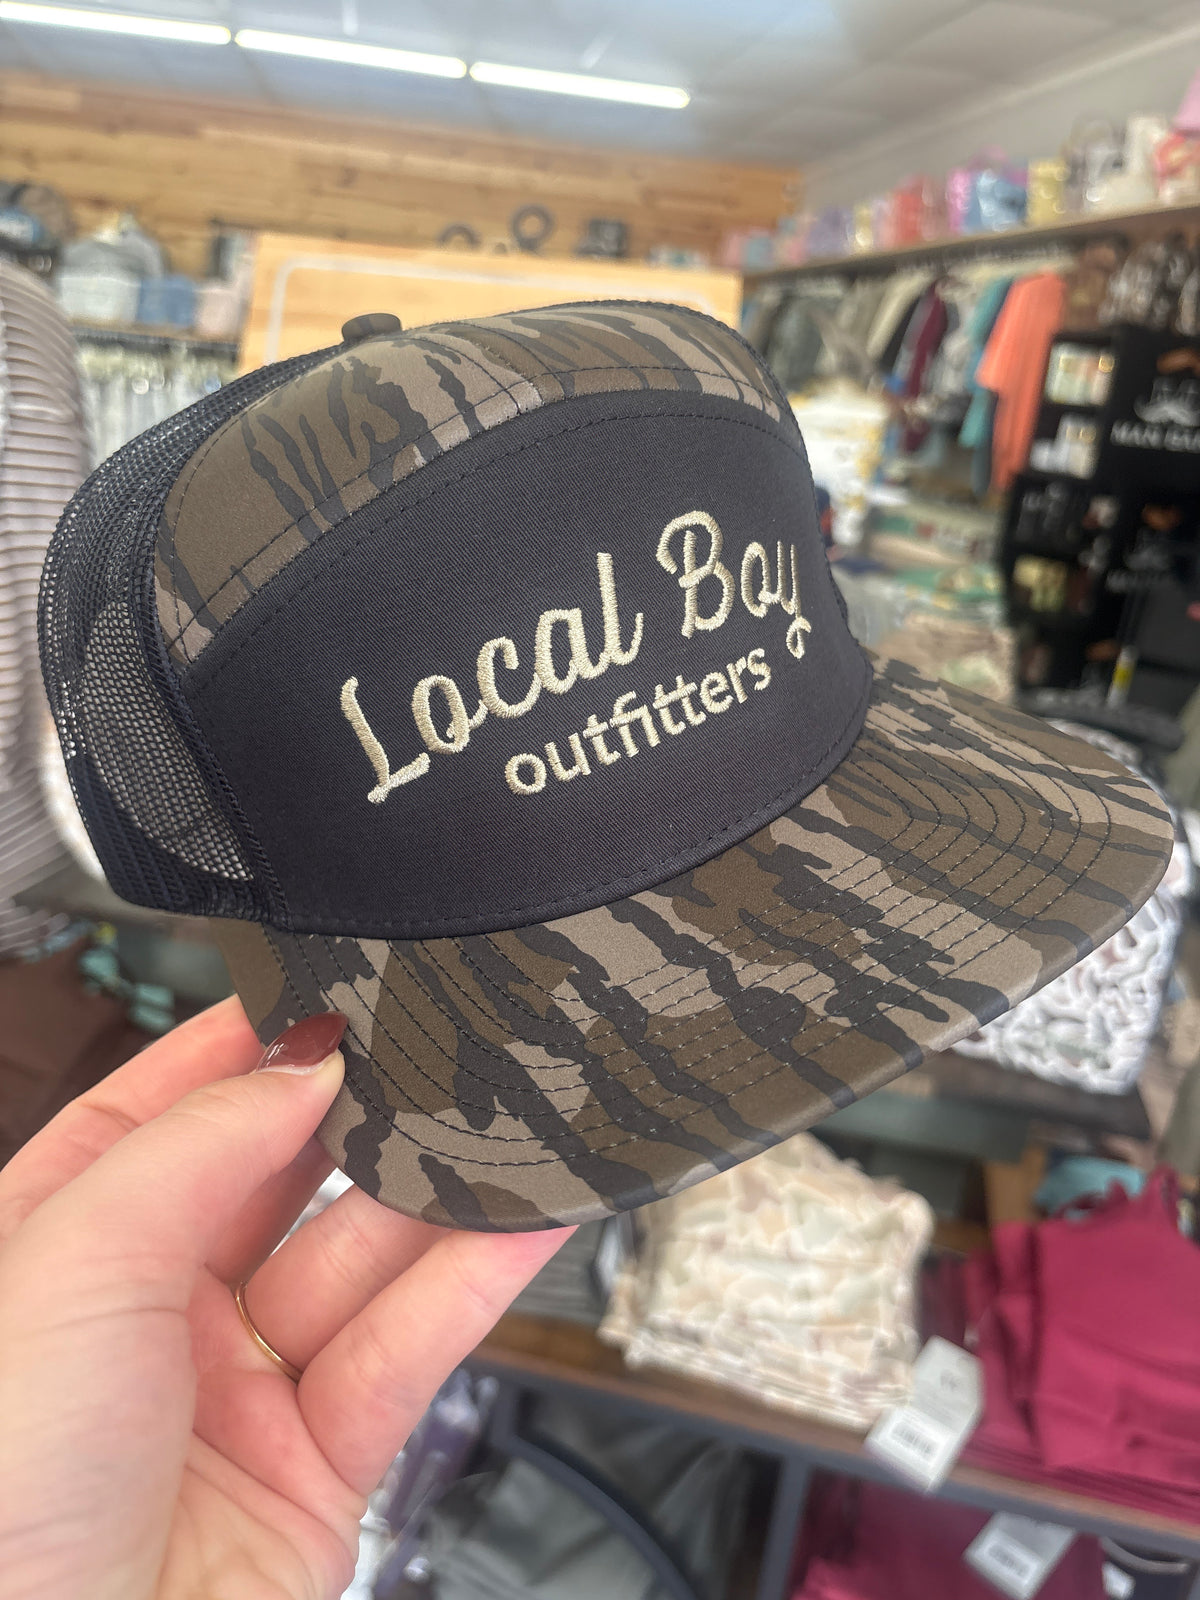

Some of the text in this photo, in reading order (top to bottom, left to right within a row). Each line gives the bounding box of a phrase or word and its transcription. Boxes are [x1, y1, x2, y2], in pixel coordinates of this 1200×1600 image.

[340, 510, 812, 804] Local Boy
[504, 648, 772, 796] outfitters
